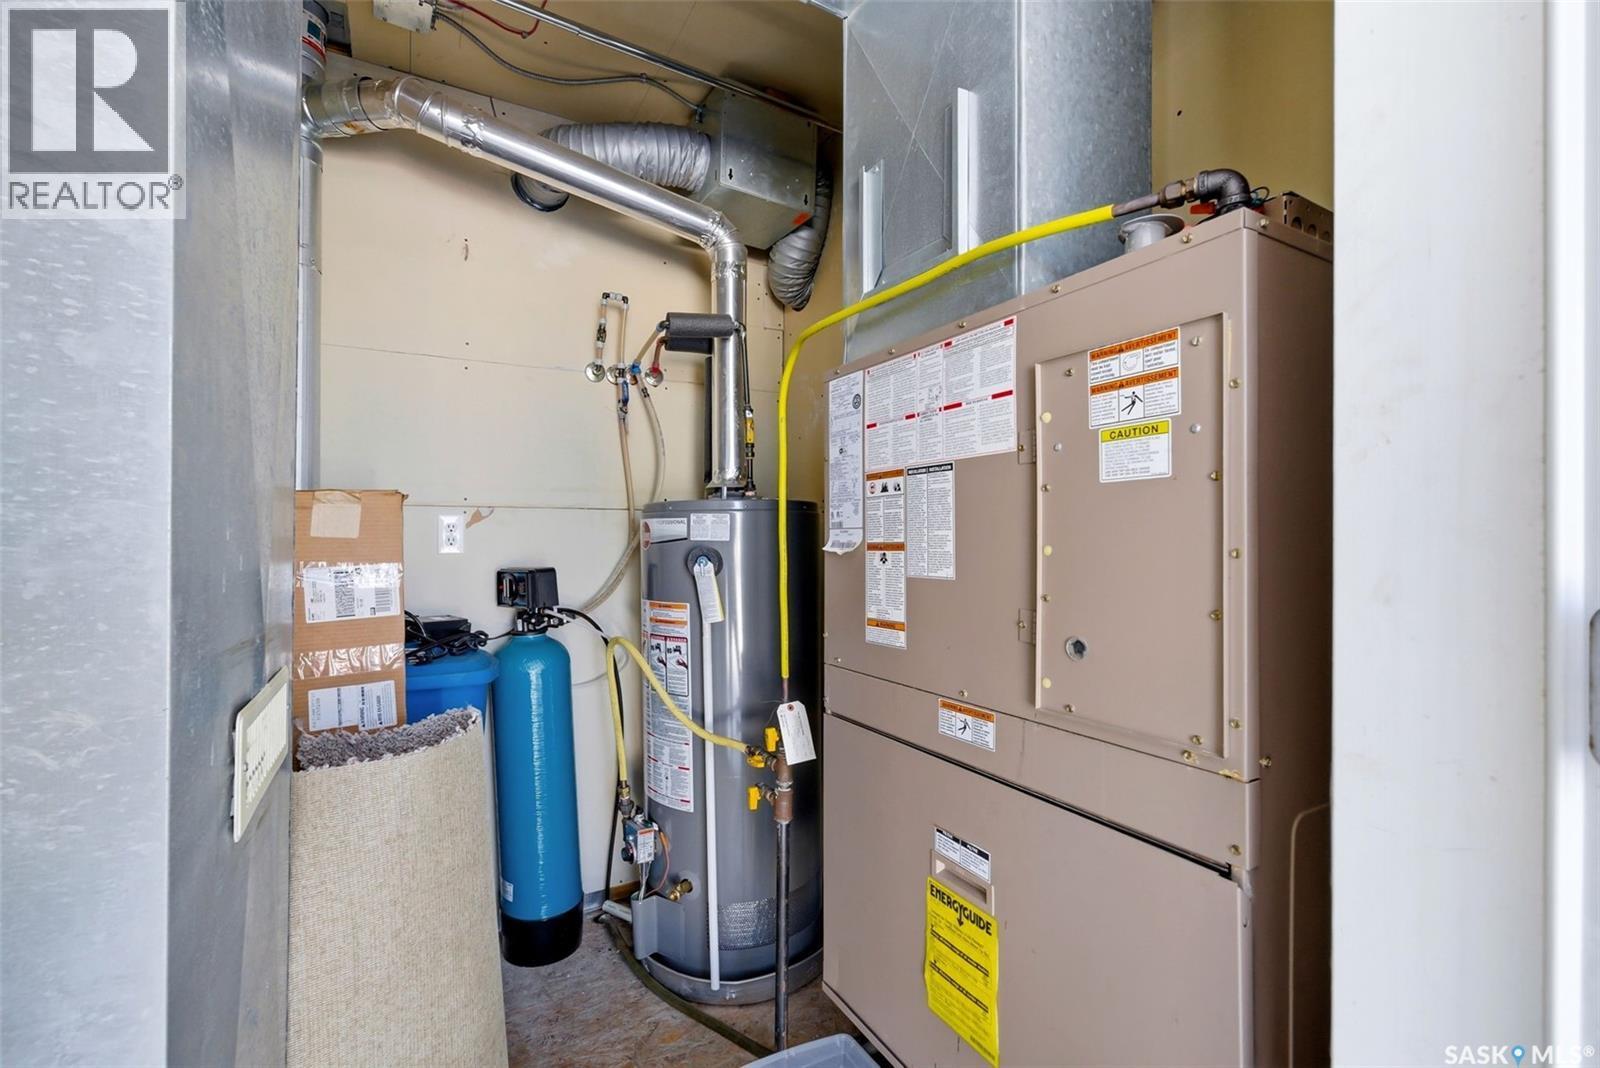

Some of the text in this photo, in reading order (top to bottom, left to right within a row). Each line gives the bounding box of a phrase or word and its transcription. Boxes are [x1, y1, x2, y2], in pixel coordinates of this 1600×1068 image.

[1091, 331, 1177, 360] WARNING AVERTISSEMENT
[1091, 370, 1177, 394] WARNING AVERTISSEMENT
[1109, 424, 1159, 440] CAUTION
[929, 883, 992, 936] ENERGYGUIDE
